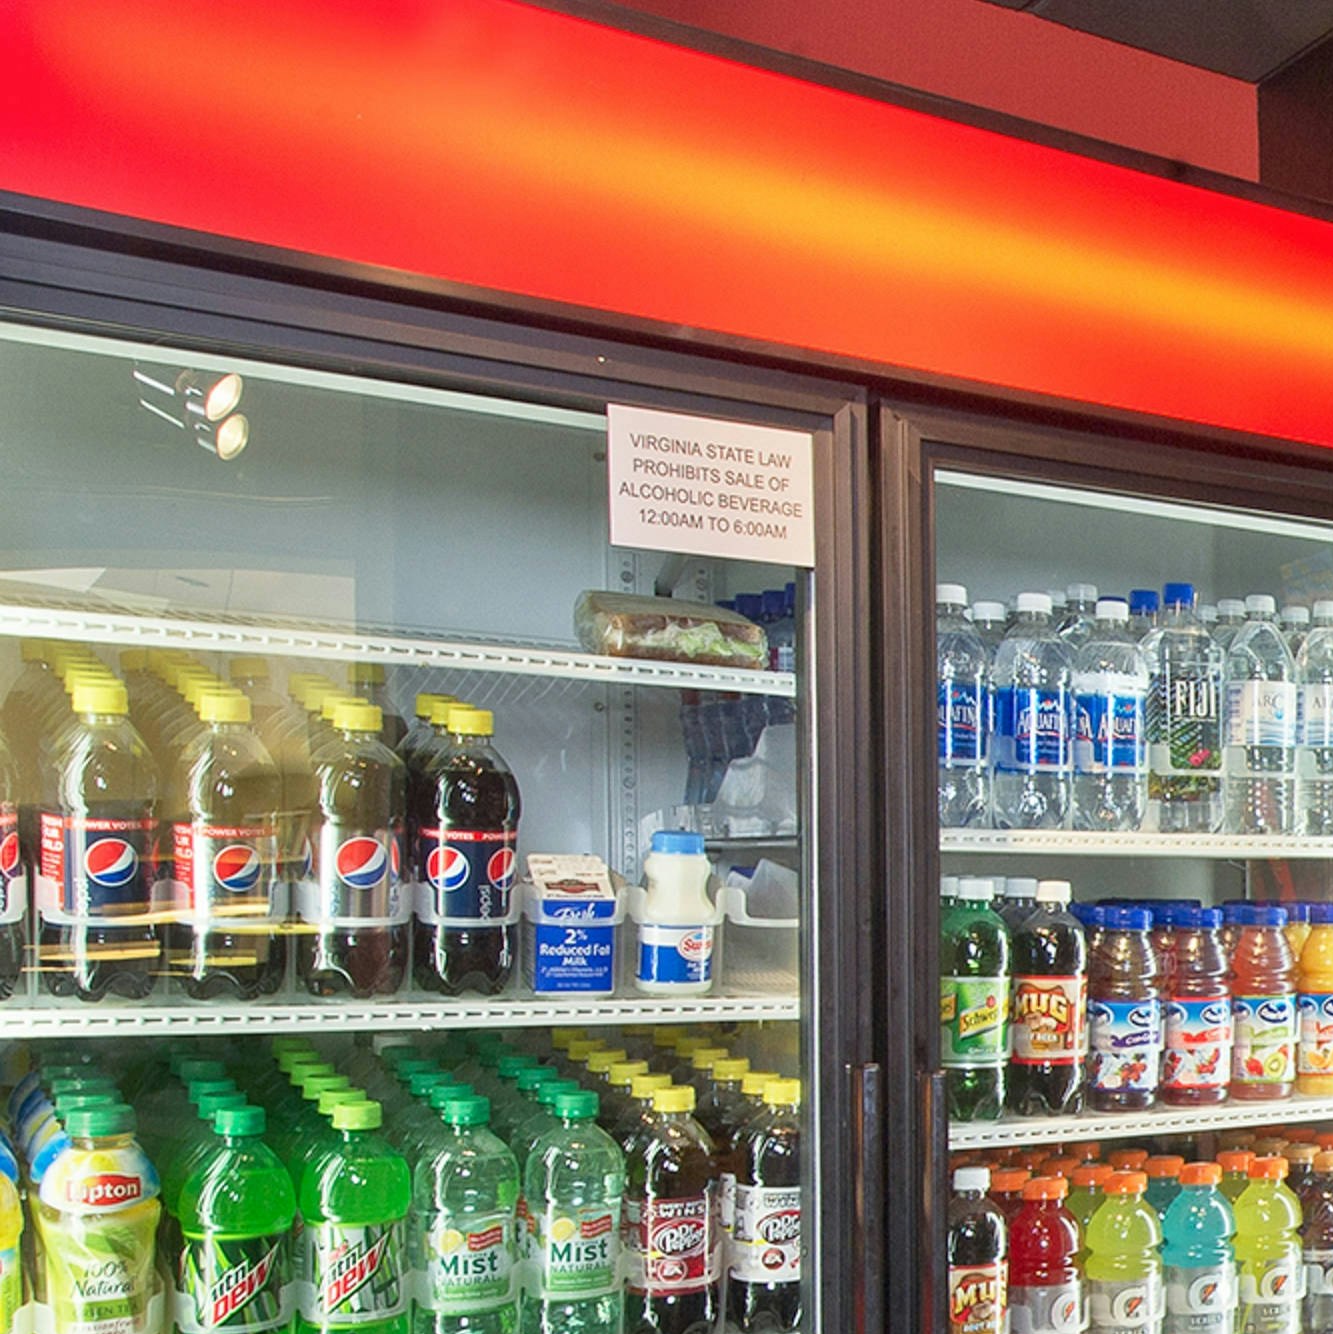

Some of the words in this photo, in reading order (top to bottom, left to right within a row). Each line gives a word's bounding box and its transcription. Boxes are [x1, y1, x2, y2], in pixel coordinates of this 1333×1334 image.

[629, 433, 702, 457] VIRGINIA
[706, 443, 754, 465] STATE
[759, 449, 792, 469] LAW
[633, 458, 720, 483] PROHIBITS
[725, 470, 764, 490] SALE
[768, 476, 789, 492] OF
[619, 482, 714, 506] ALCOHOLIC
[718, 494, 803, 518] BEVERAGE
[639, 509, 703, 529] 12:00AM
[708, 516, 729, 533] TO
[733, 519, 788, 539] 6:00AM
[1175, 680, 1216, 717] FIJI
[539, 943, 592, 956] Reduced
[593, 945, 610, 956] Fat
[564, 928, 588, 944] 2%
[562, 957, 587, 966] Milk
[1017, 992, 1067, 1023] MUG
[69, 1182, 138, 1202] Lipton
[440, 1250, 498, 1277] Mist
[551, 1240, 608, 1262] Mist
